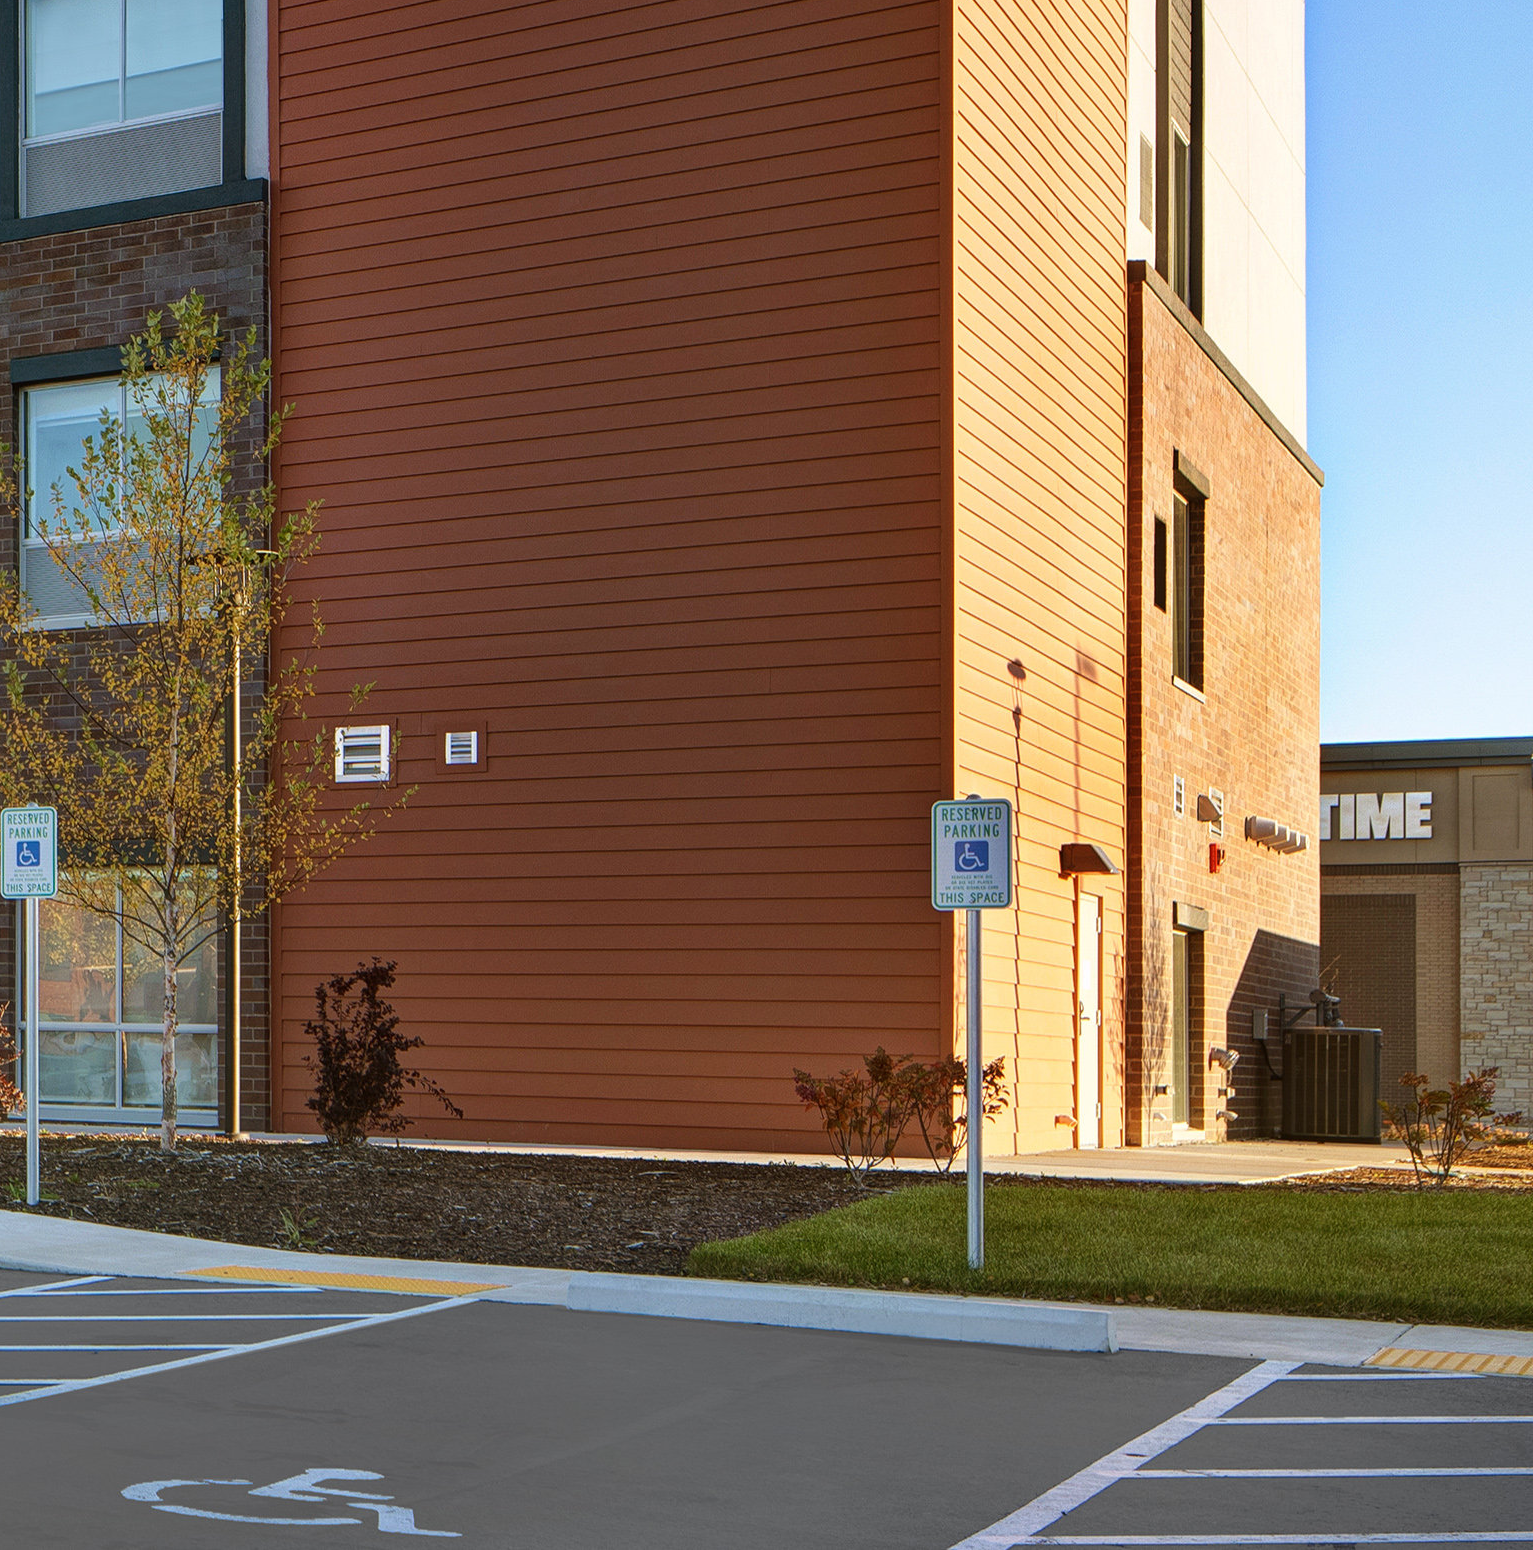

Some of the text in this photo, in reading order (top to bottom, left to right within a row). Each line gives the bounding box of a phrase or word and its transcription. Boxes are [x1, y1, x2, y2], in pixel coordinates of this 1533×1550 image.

[7, 812, 50, 825] RESERVED
[941, 806, 1002, 822] RESERVED
[1320, 791, 1433, 841] TIME
[9, 827, 48, 839] PARKING
[944, 823, 1000, 838] PARKING
[6, 883, 51, 892] THIS SPACE
[939, 892, 1005, 903] THIS SPACE
